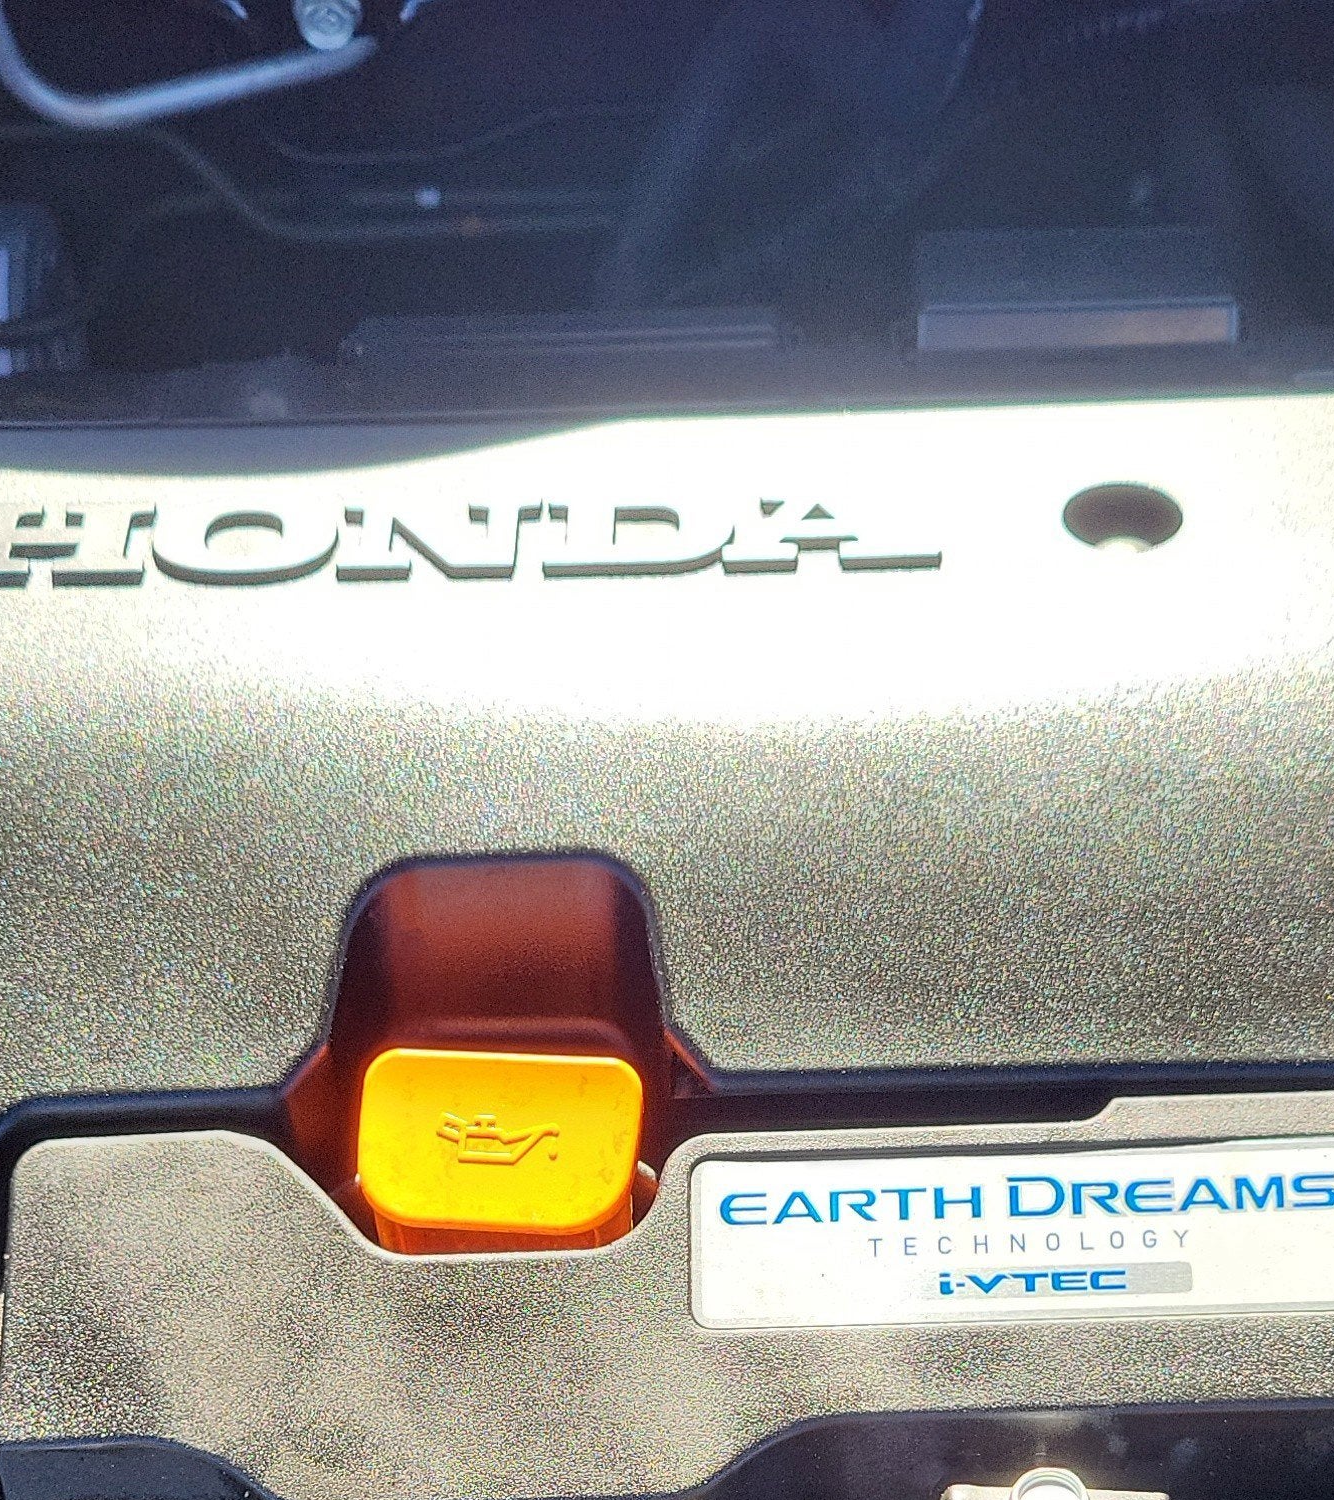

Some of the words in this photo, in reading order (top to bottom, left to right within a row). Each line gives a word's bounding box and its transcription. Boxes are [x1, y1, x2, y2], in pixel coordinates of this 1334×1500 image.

[719, 1185, 983, 1226] EARTH
[868, 1228, 1193, 1258] TECHNOLOGY
[939, 1270, 1128, 1296] i-VTEC
